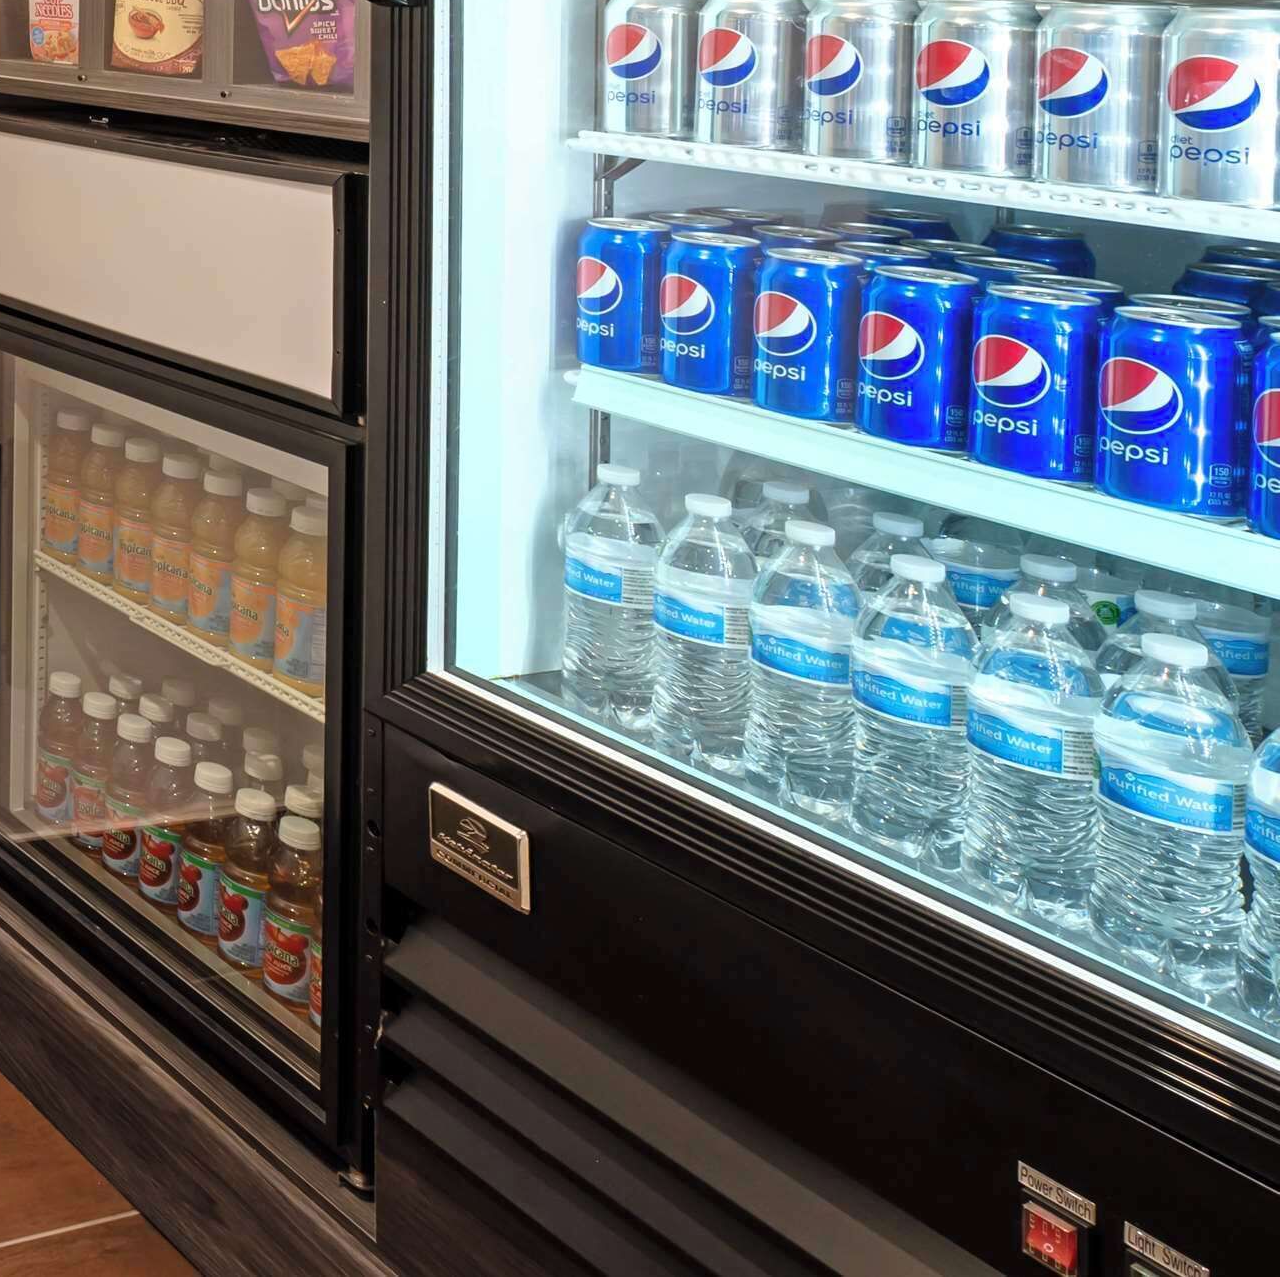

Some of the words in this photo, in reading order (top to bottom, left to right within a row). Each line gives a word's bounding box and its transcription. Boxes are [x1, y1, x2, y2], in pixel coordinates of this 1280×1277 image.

[34, 3, 74, 20] NOODLES
[310, 26, 336, 35] SWEET
[312, 20, 336, 28] SPICY
[607, 88, 656, 108] pepsi
[698, 96, 748, 116] pepsi
[802, 105, 854, 127] pepsi
[916, 117, 981, 139] pepsi
[1034, 127, 1099, 150] pepsi
[1170, 133, 1194, 146] diet
[1169, 143, 1251, 167] pepsi
[576, 320, 614, 340] pepsi
[660, 336, 706, 360] pepsi
[754, 358, 807, 383] pepsi
[857, 381, 914, 409] pepsi
[972, 408, 1039, 437] pepsi
[1099, 434, 1170, 467] pepsi
[1213, 466, 1230, 477] 150
[582, 573, 616, 590] Water
[681, 611, 717, 629] Water
[757, 636, 803, 663] Purified
[804, 653, 845, 671] Water
[855, 674, 897, 702] Purified
[900, 693, 943, 711] Water
[1006, 734, 1053, 756] Water
[1108, 771, 1171, 804] Purified
[1175, 794, 1225, 815] Water
[1020, 1165, 1053, 1197] Power
[1055, 1188, 1092, 1221] Switch
[1127, 1226, 1158, 1259] Light
[1161, 1247, 1203, 1277] Switch
